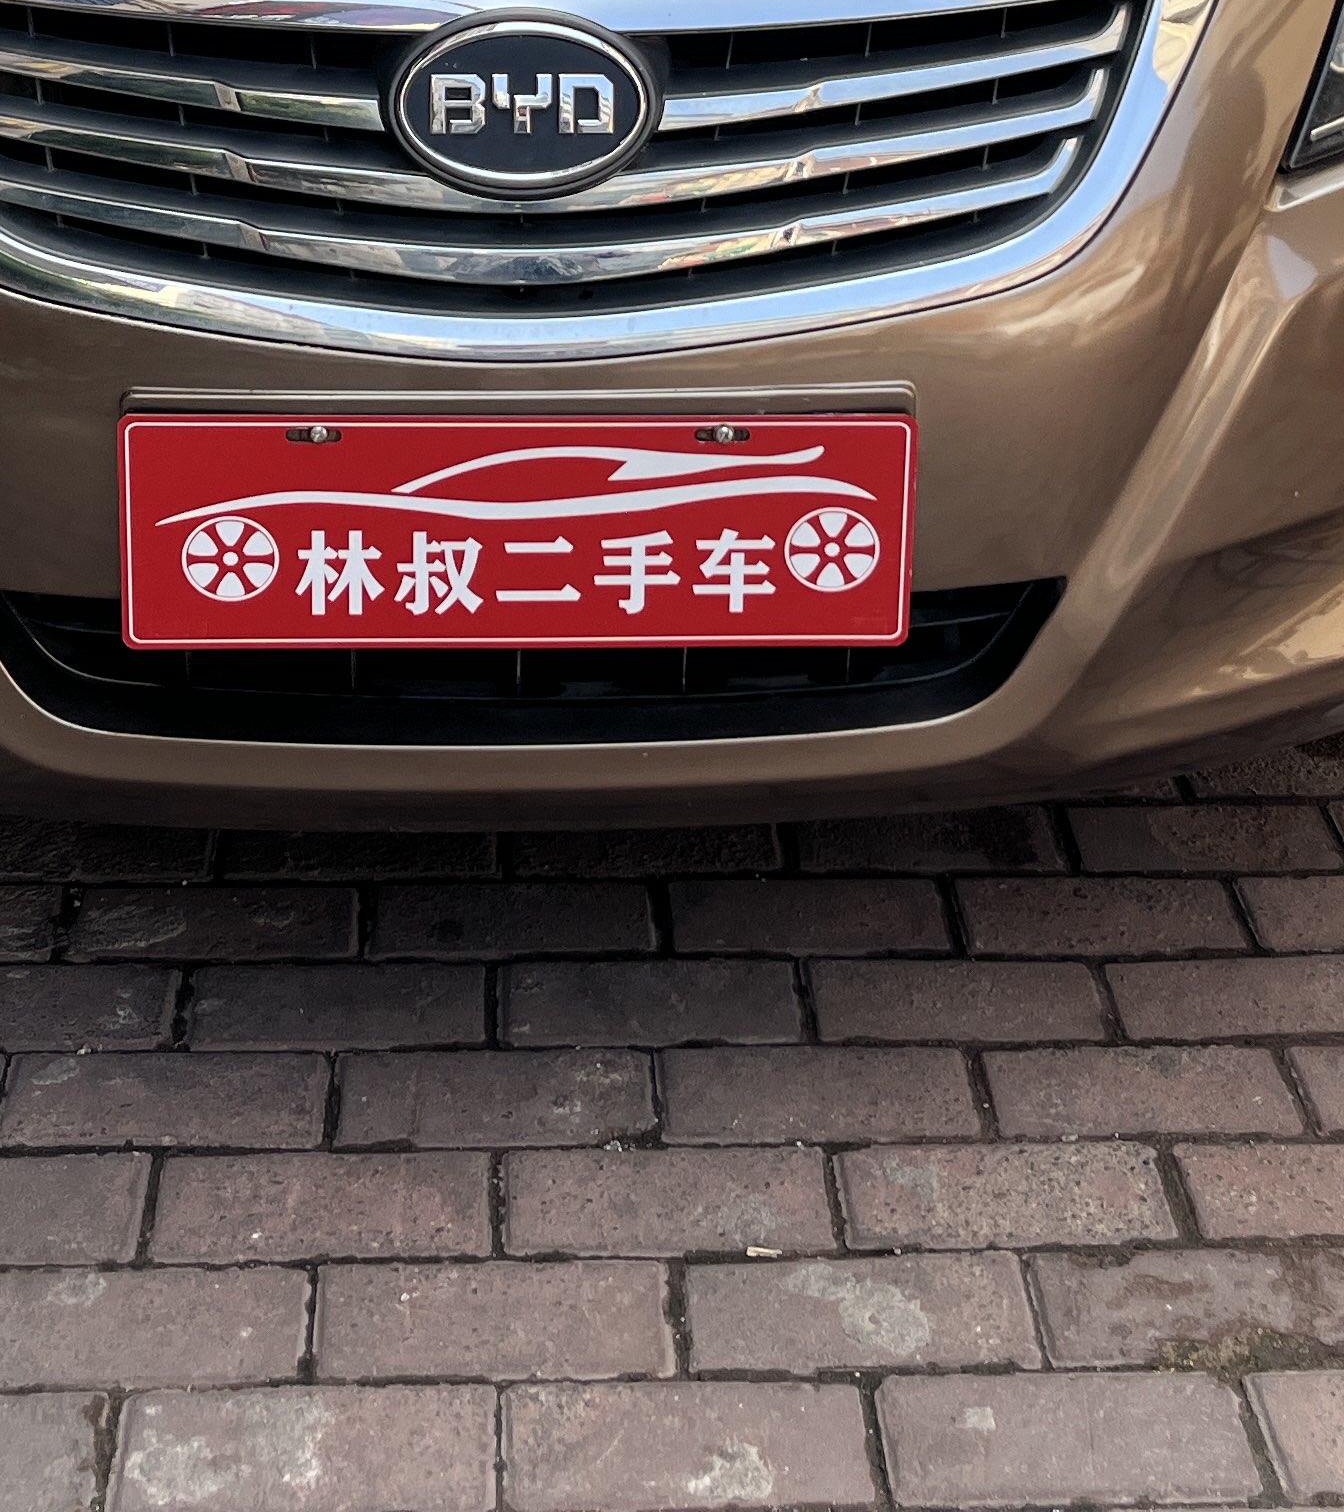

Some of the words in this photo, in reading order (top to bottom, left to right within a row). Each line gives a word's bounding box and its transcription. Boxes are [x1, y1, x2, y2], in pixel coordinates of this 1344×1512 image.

[430, 73, 614, 135] BYD
[294, 528, 777, 616] 林叔二手车
